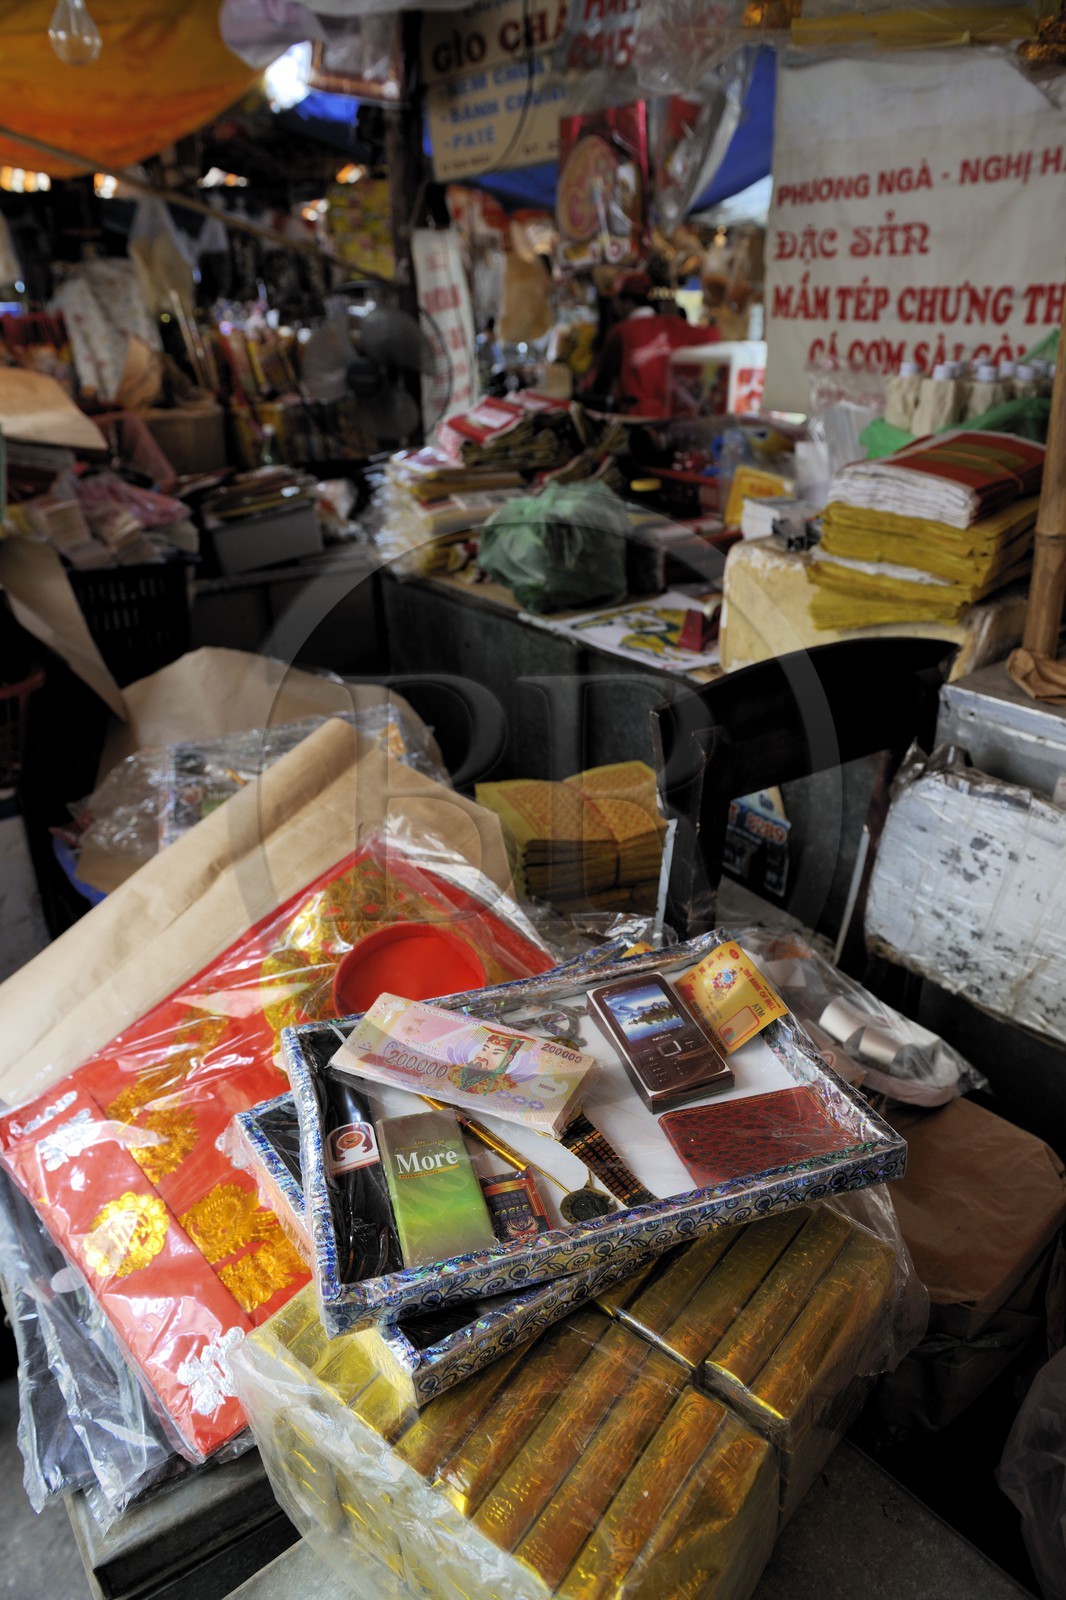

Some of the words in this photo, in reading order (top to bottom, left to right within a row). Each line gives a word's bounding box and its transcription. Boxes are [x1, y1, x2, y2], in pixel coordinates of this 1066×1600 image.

[959, 149, 1034, 187] NGHỊ
[1040, 144, 1066, 176] H
[774, 223, 840, 265] ĐẶC
[896, 279, 1015, 327] CHƯNG
[752, 1003, 765, 1018] ATM
[385, 1049, 449, 1078] 200000
[394, 1150, 459, 1174] More
[495, 1204, 528, 1216] EAGLE
